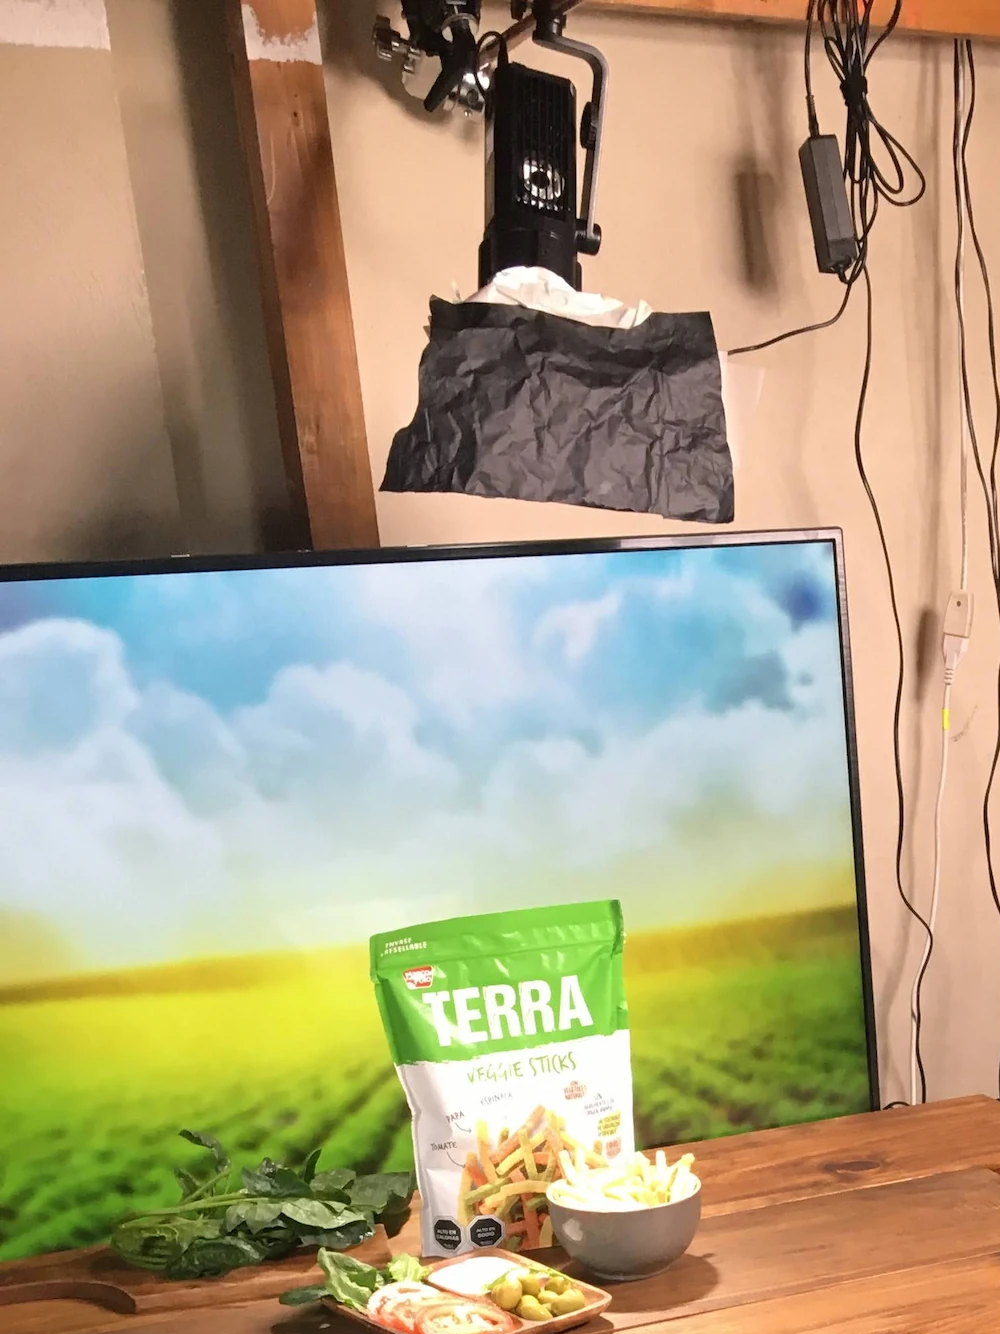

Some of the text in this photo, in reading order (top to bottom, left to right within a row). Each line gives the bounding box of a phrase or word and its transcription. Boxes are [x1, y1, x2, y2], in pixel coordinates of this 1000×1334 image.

[422, 974, 593, 1047] TERRA
[467, 1051, 576, 1084] VEGGIE STICKS
[445, 1111, 464, 1123] PAPA
[430, 1141, 457, 1151] TOMATE
